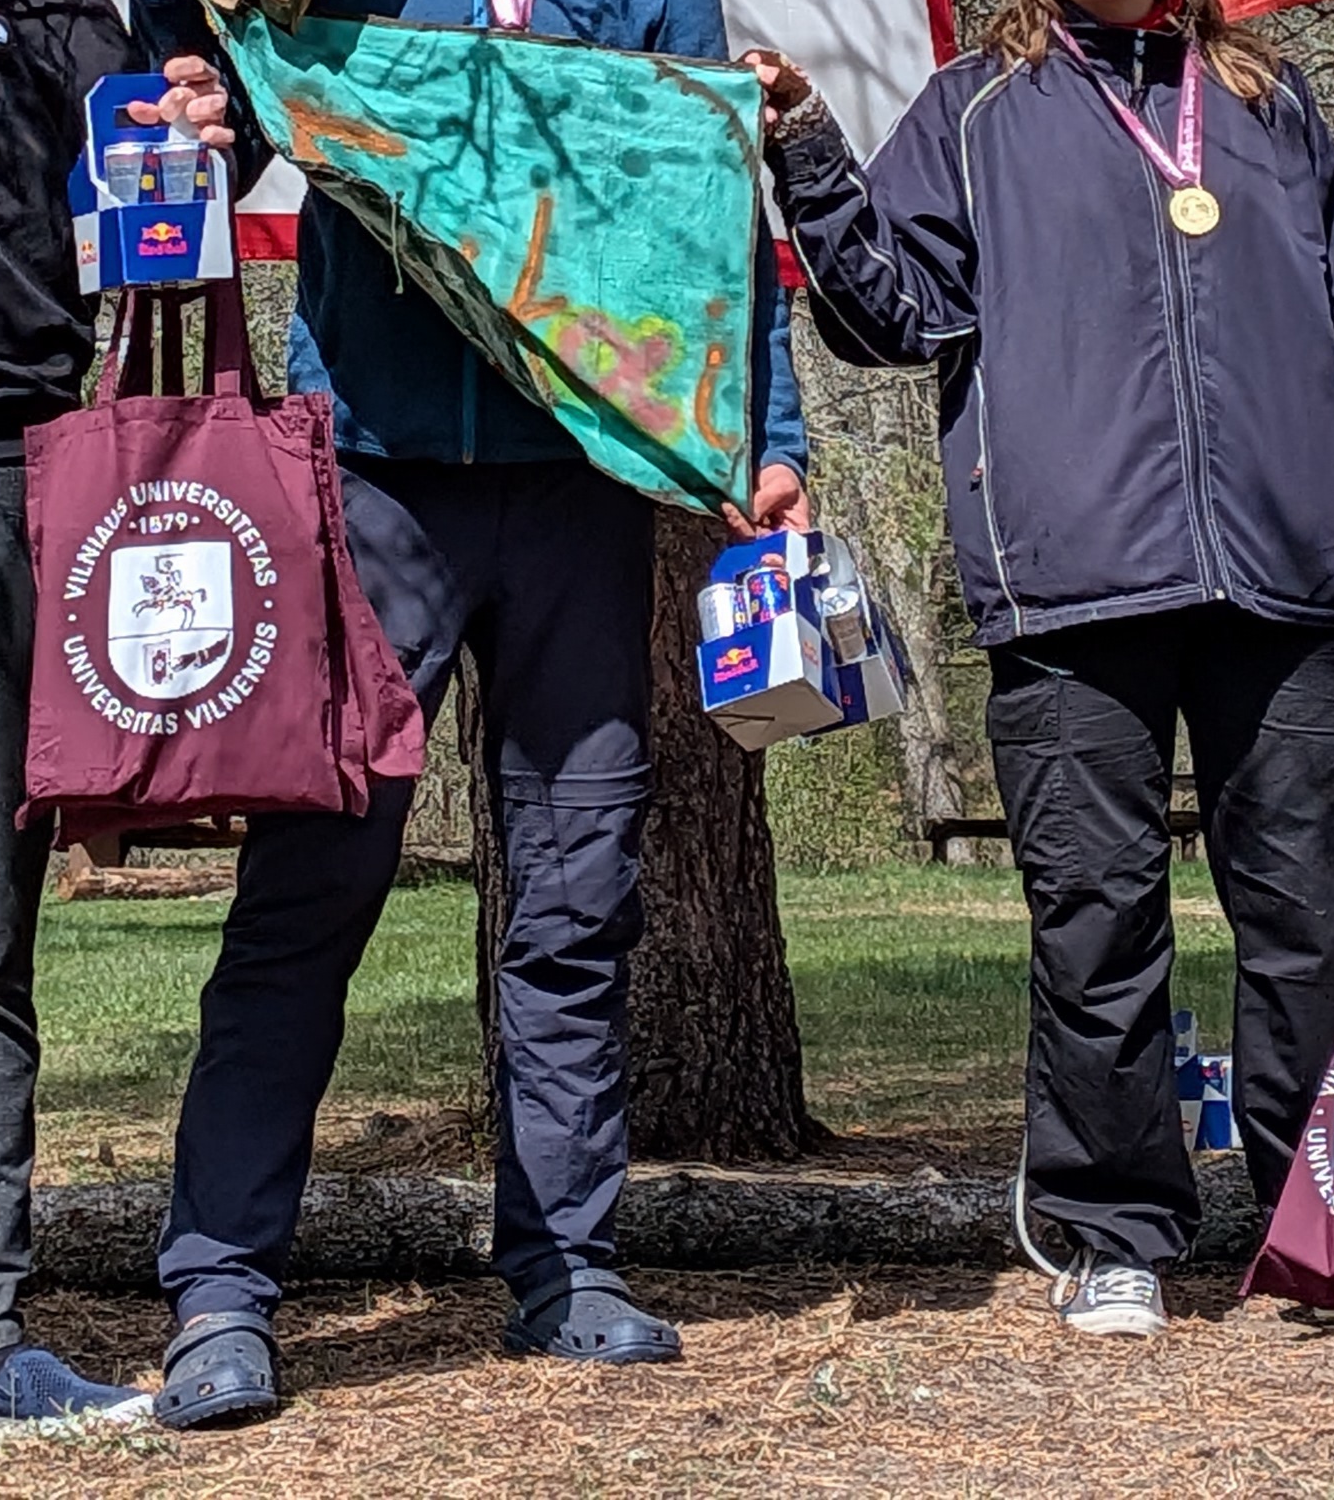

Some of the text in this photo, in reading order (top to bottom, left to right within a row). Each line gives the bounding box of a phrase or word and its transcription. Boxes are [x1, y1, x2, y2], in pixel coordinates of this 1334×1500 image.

[63, 480, 277, 600] VILNIAUS UNIVERSITETAS
[64, 622, 278, 735] UNIVERSITAS VILNENSIS
